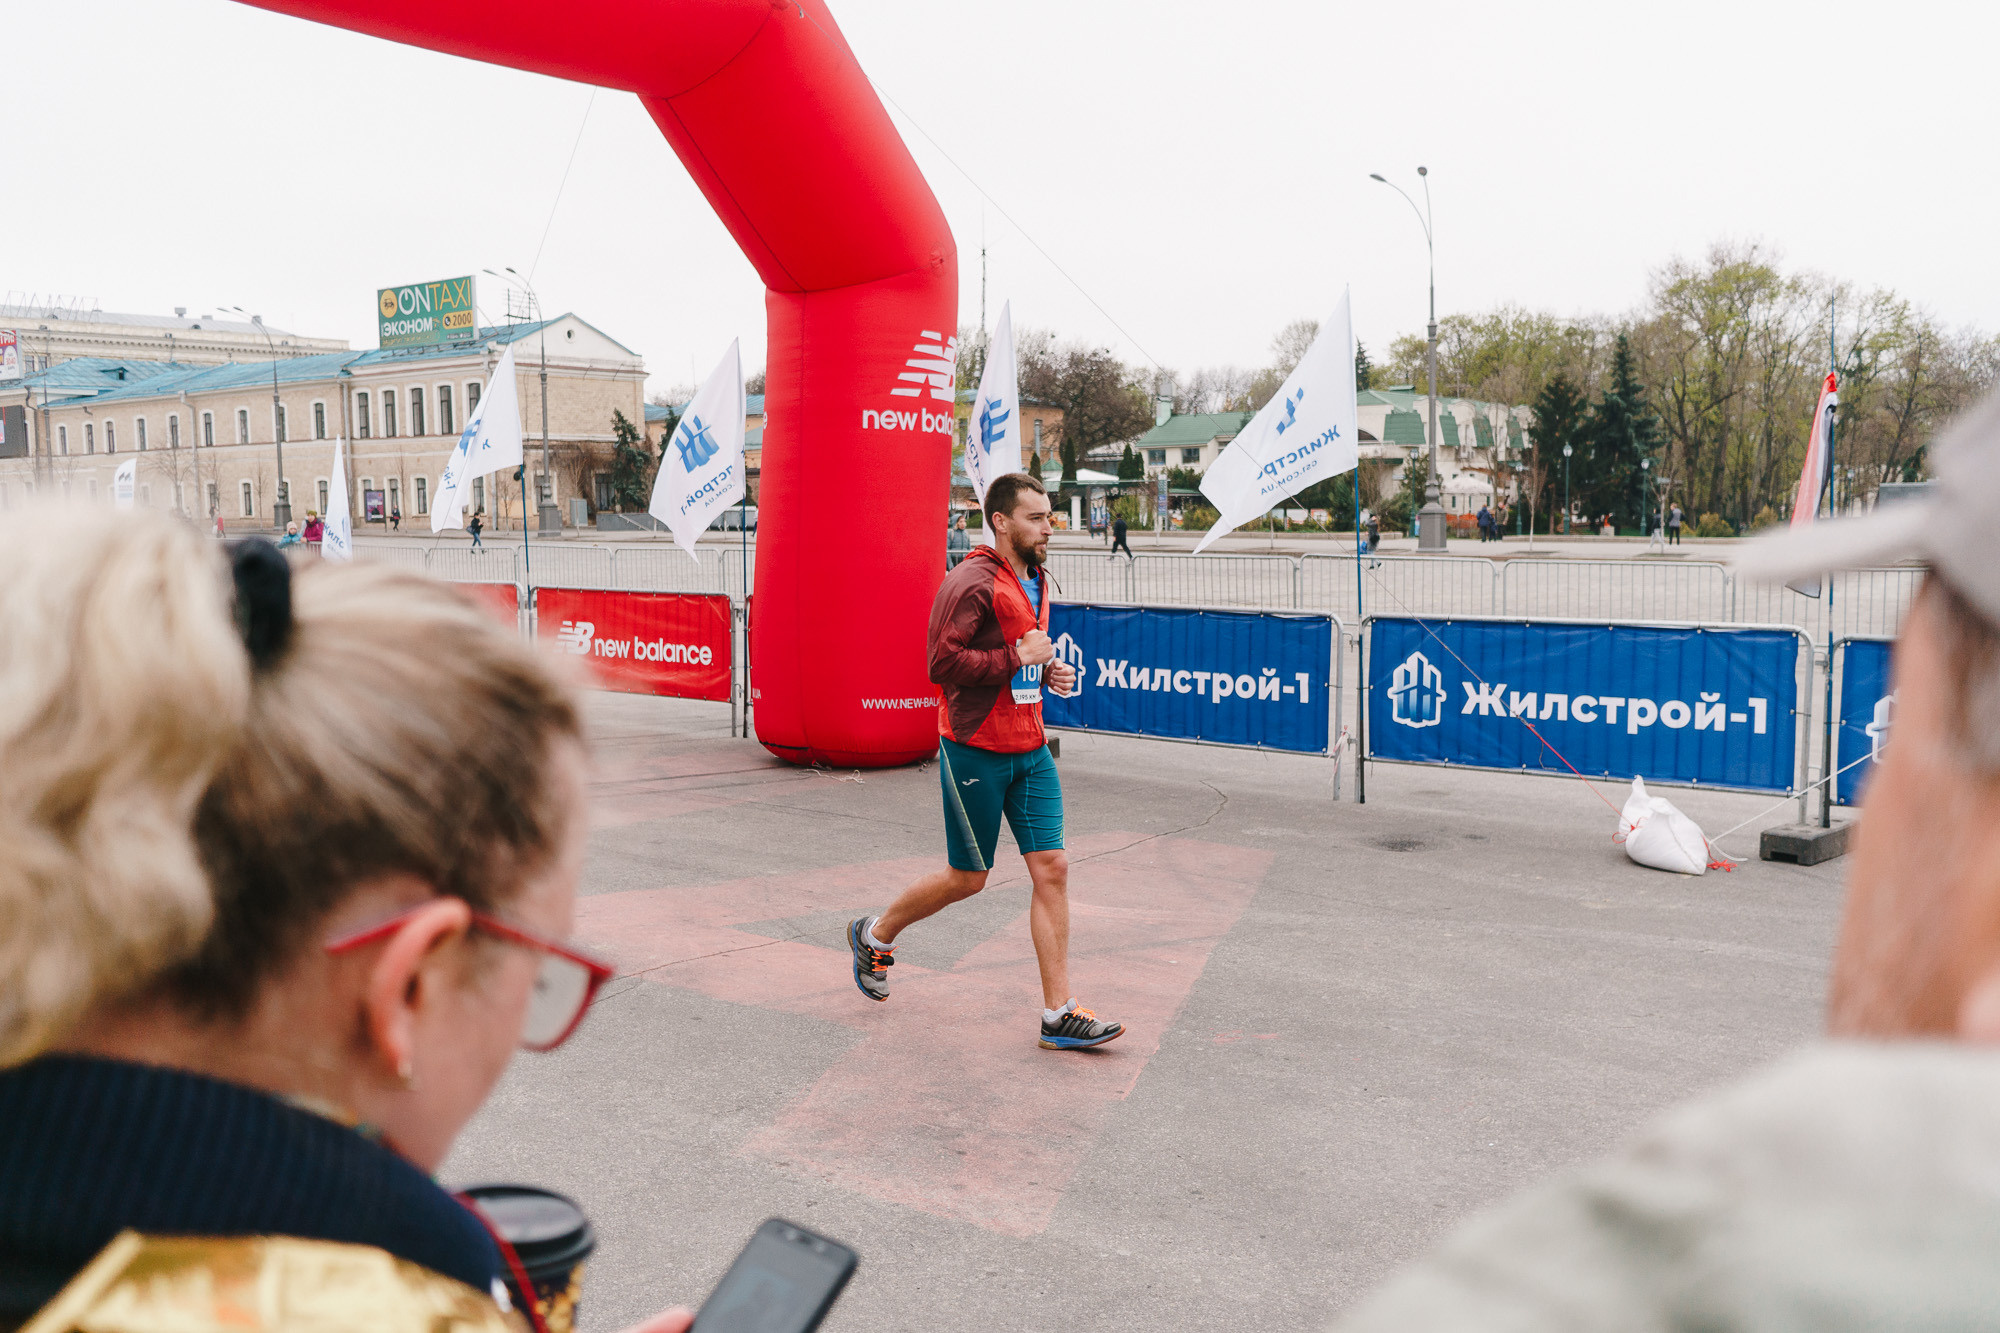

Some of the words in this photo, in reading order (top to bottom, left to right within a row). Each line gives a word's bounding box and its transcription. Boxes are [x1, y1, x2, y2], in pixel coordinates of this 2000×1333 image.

[383, 317, 433, 337] ЭКОНОМ
[453, 312, 472, 327] 2000
[862, 409, 918, 431] new
[594, 638, 631, 658] new
[634, 636, 712, 666] balance
[1095, 658, 1309, 704] Жилстрой-1
[1461, 681, 1768, 735] Жилстрой-1
